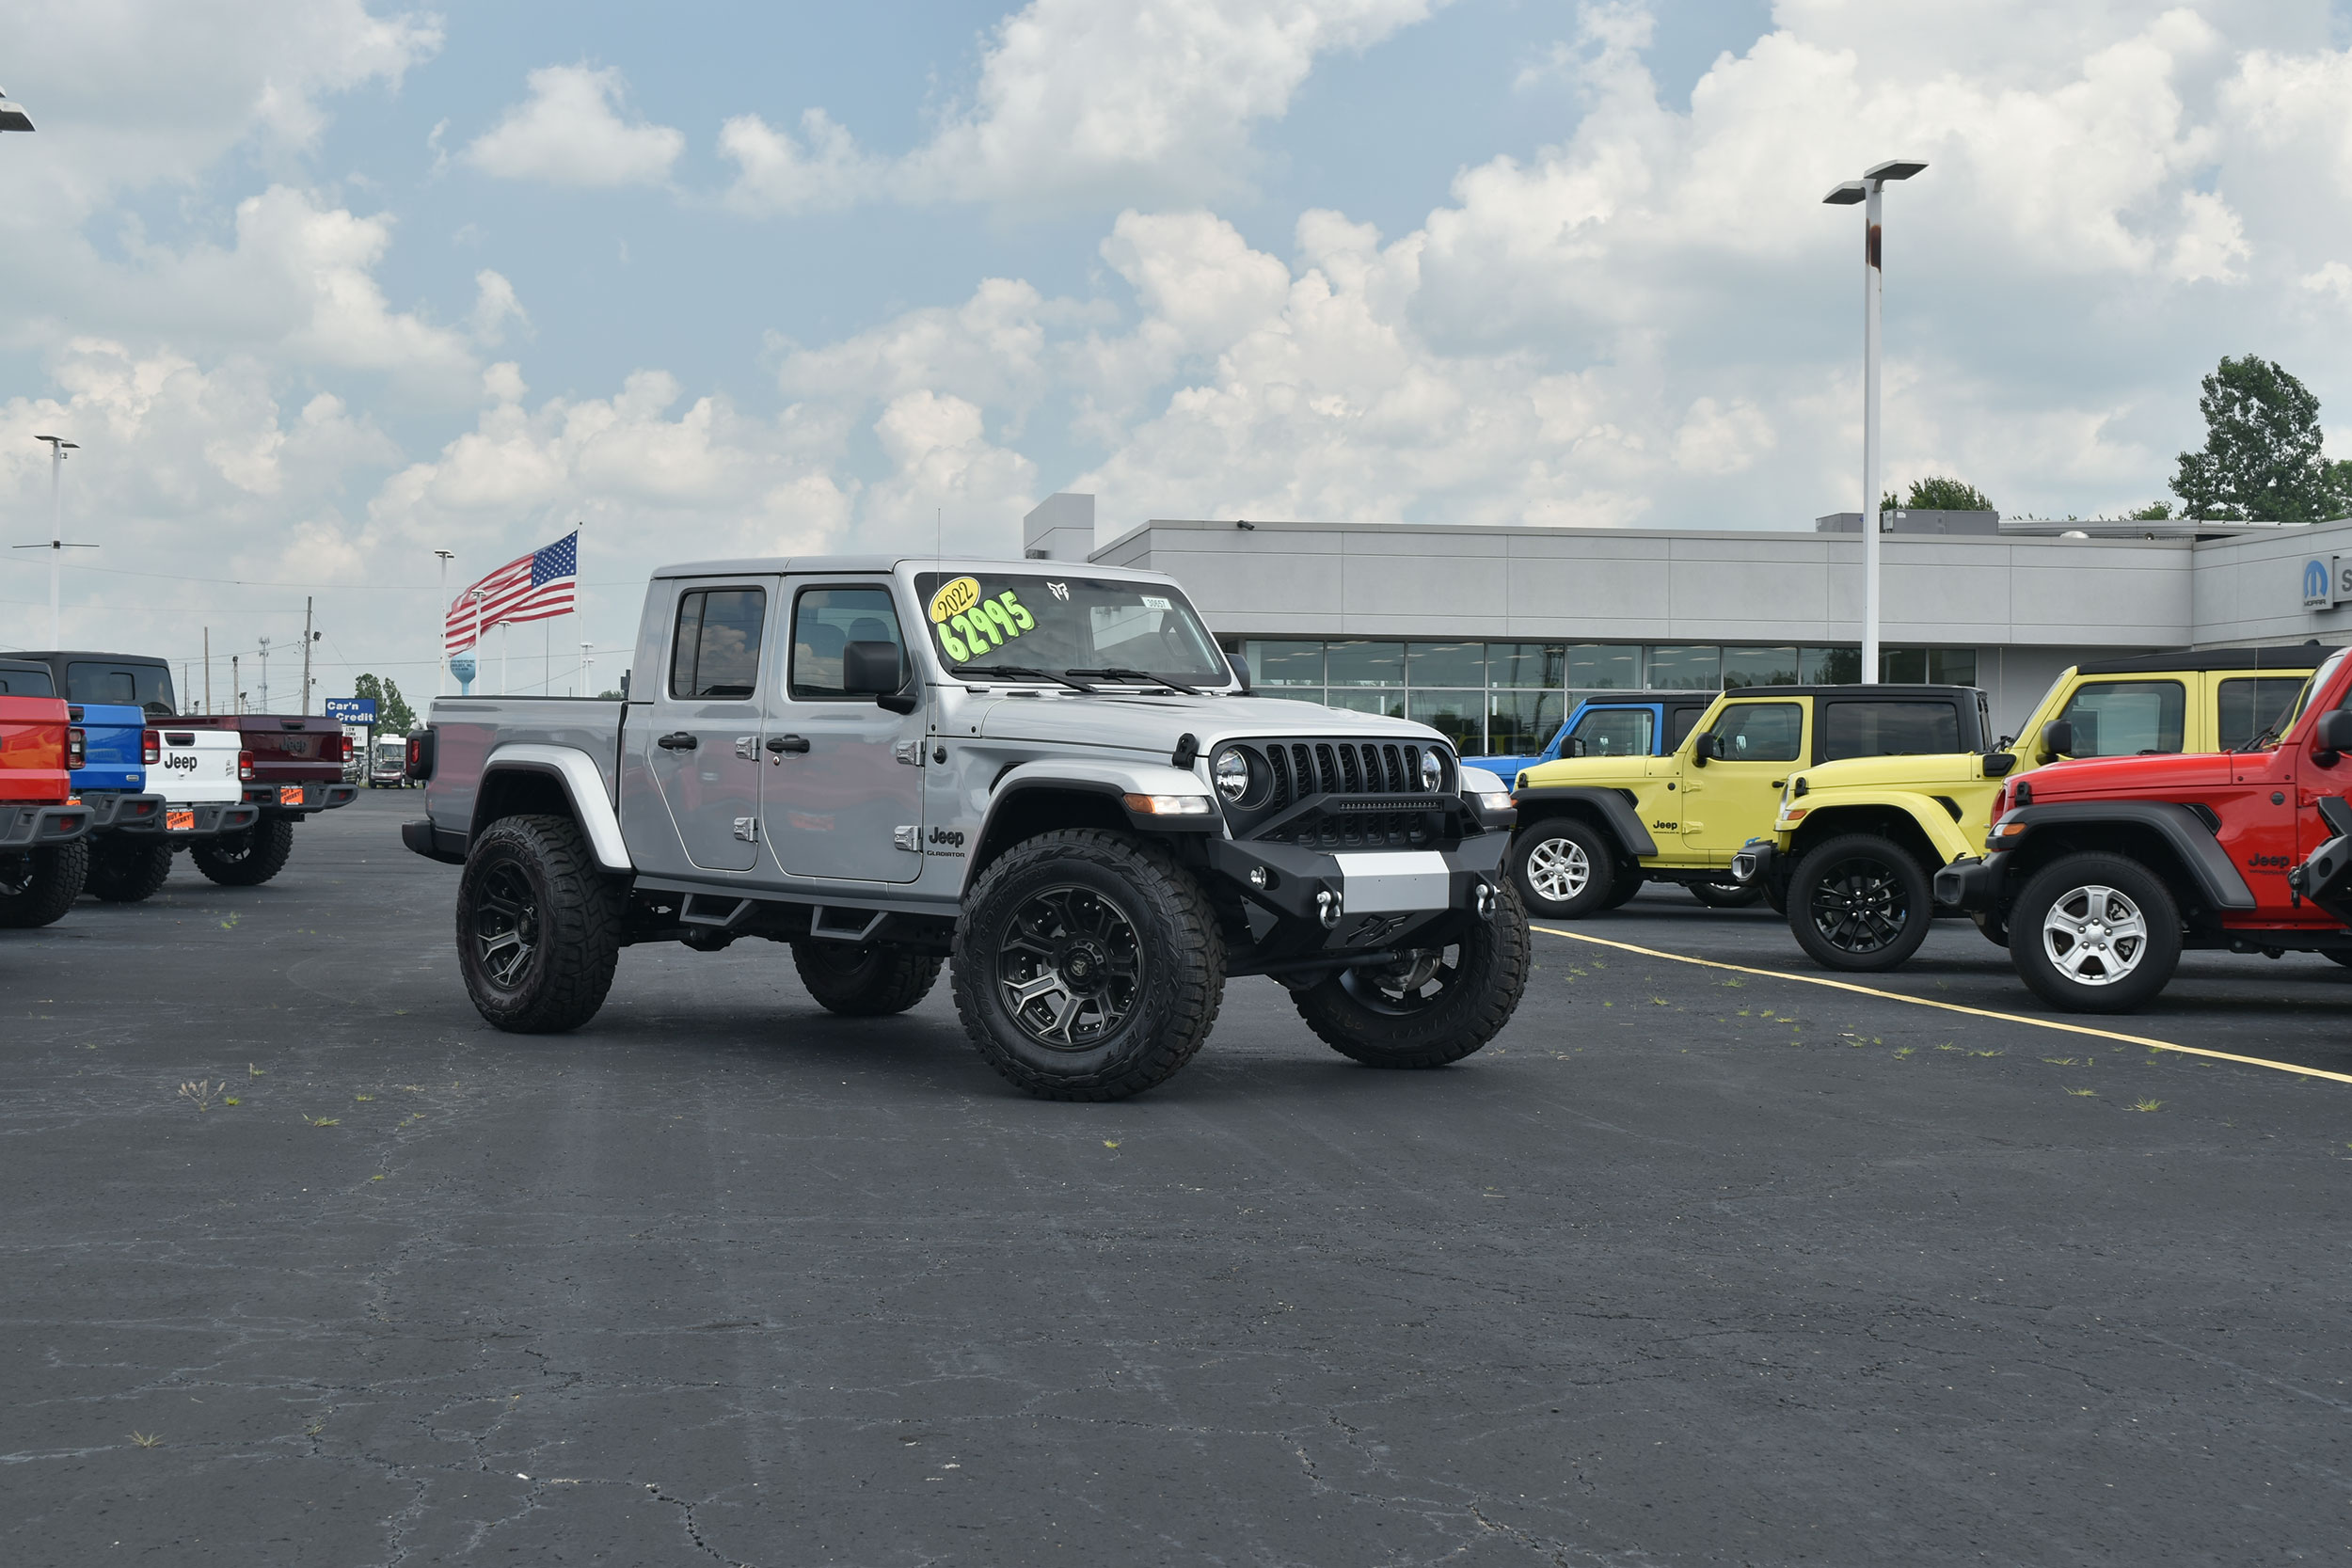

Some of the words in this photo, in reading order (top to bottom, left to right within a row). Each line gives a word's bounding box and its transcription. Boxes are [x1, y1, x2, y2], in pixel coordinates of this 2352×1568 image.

[938, 581, 974, 619] 2022
[937, 591, 1035, 662] 62995
[326, 702, 359, 710] Car'n
[336, 713, 373, 721] Credit
[279, 736, 308, 753] Jeep
[164, 752, 198, 772] Jeep
[1653, 820, 1677, 831] Jeep
[929, 827, 964, 848] Jeep
[2249, 852, 2290, 868] Jeep
